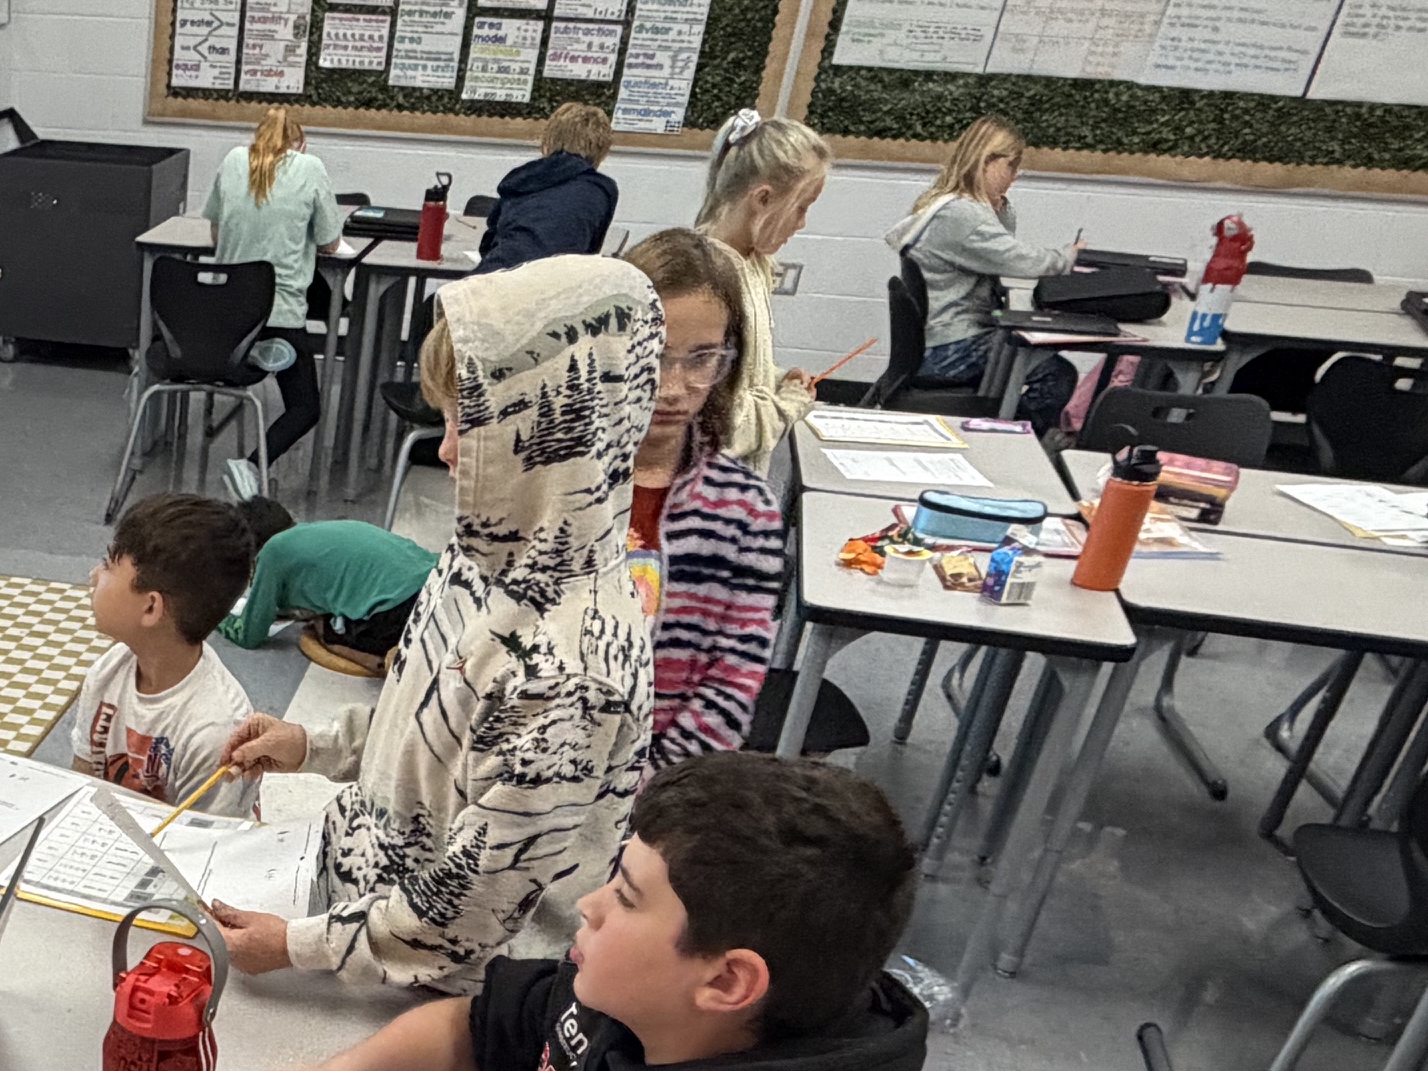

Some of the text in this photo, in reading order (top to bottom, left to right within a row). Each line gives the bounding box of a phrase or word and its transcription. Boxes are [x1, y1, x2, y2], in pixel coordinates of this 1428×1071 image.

[247, 15, 290, 26] quantity
[400, 9, 456, 20] perimeter
[179, 17, 214, 32] greater
[476, 20, 502, 31] area
[633, 23, 672, 35] divisor
[554, 25, 617, 38] subtraction
[473, 33, 507, 45] model
[208, 45, 230, 56] than
[548, 52, 608, 65] difference
[174, 62, 201, 73] equal
[615, 106, 675, 118] remainder
